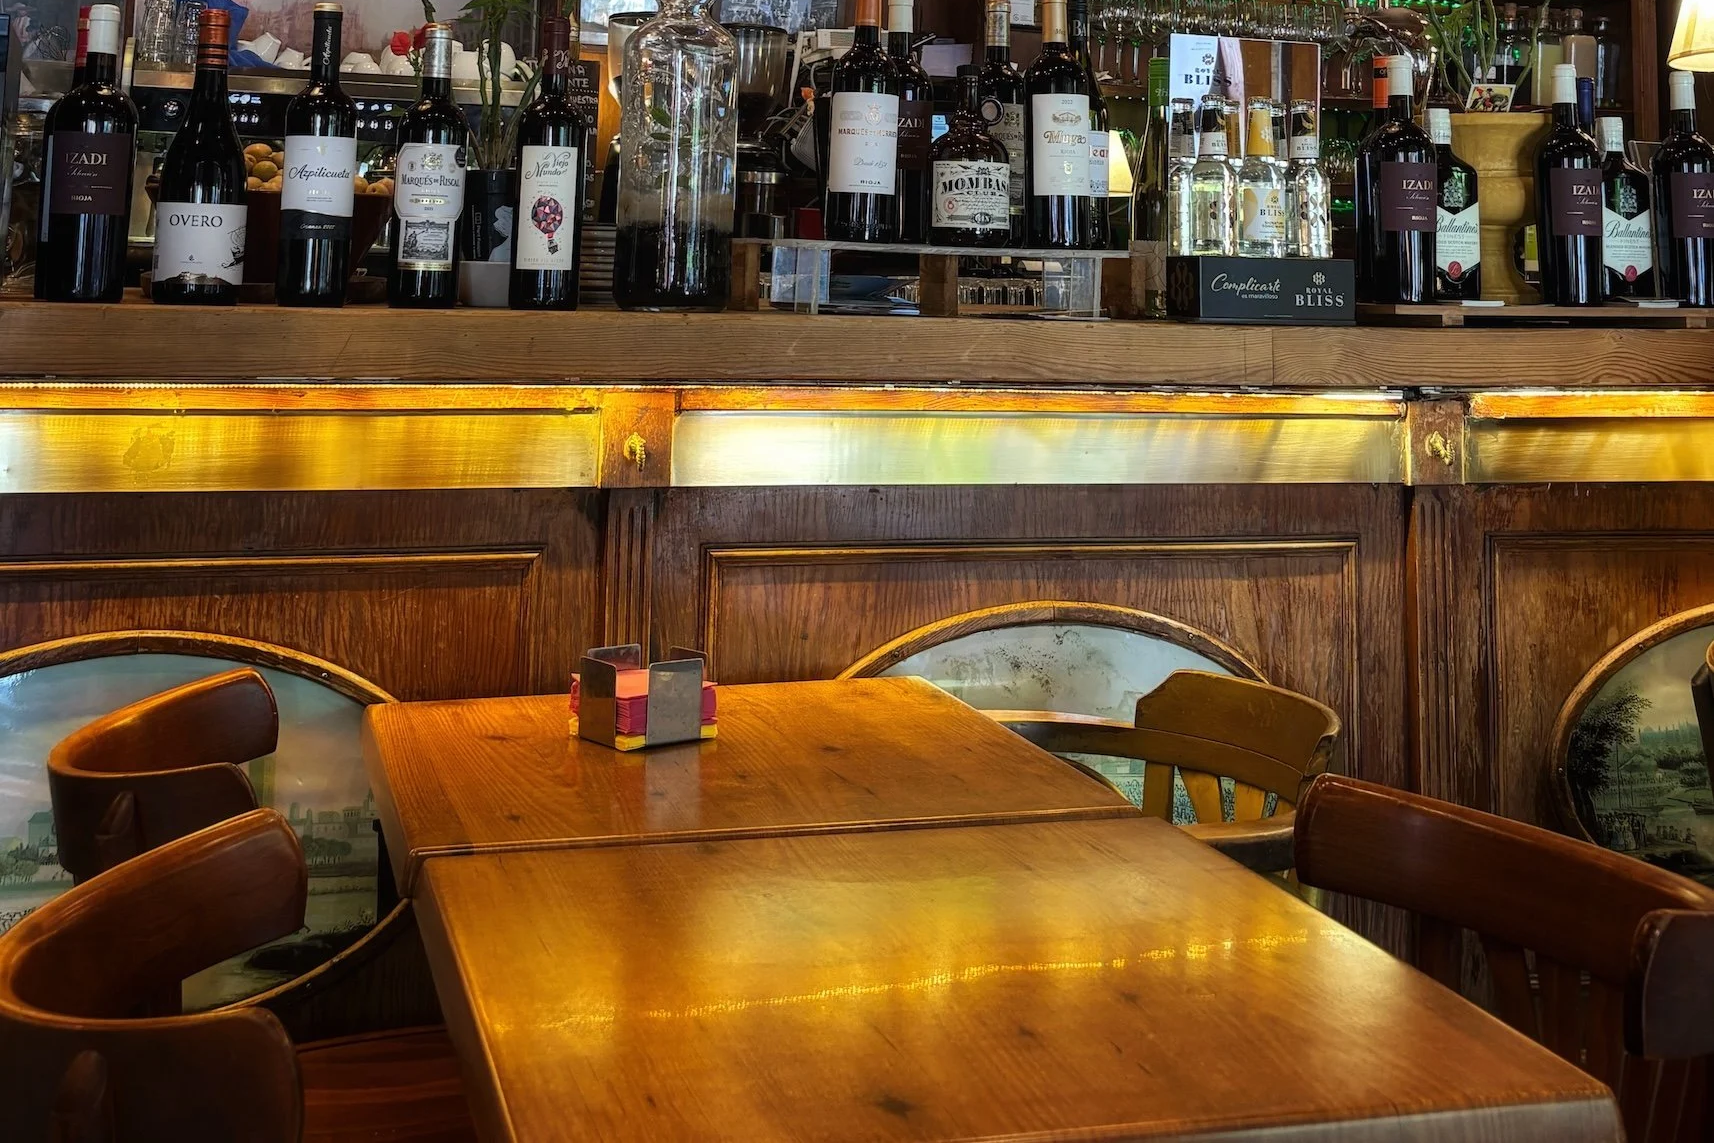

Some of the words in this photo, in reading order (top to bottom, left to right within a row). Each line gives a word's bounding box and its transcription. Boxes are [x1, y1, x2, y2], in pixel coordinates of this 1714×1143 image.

[65, 152, 108, 166] IZADI
[289, 164, 351, 185] Azpilicueta
[401, 173, 433, 186] MARQUÉS
[941, 177, 1009, 195] MOMBAS
[169, 213, 223, 228] OVERO
[1211, 273, 1281, 297] Complicarte
[1305, 286, 1332, 294] ROYAL
[1295, 294, 1345, 308] BLISS
